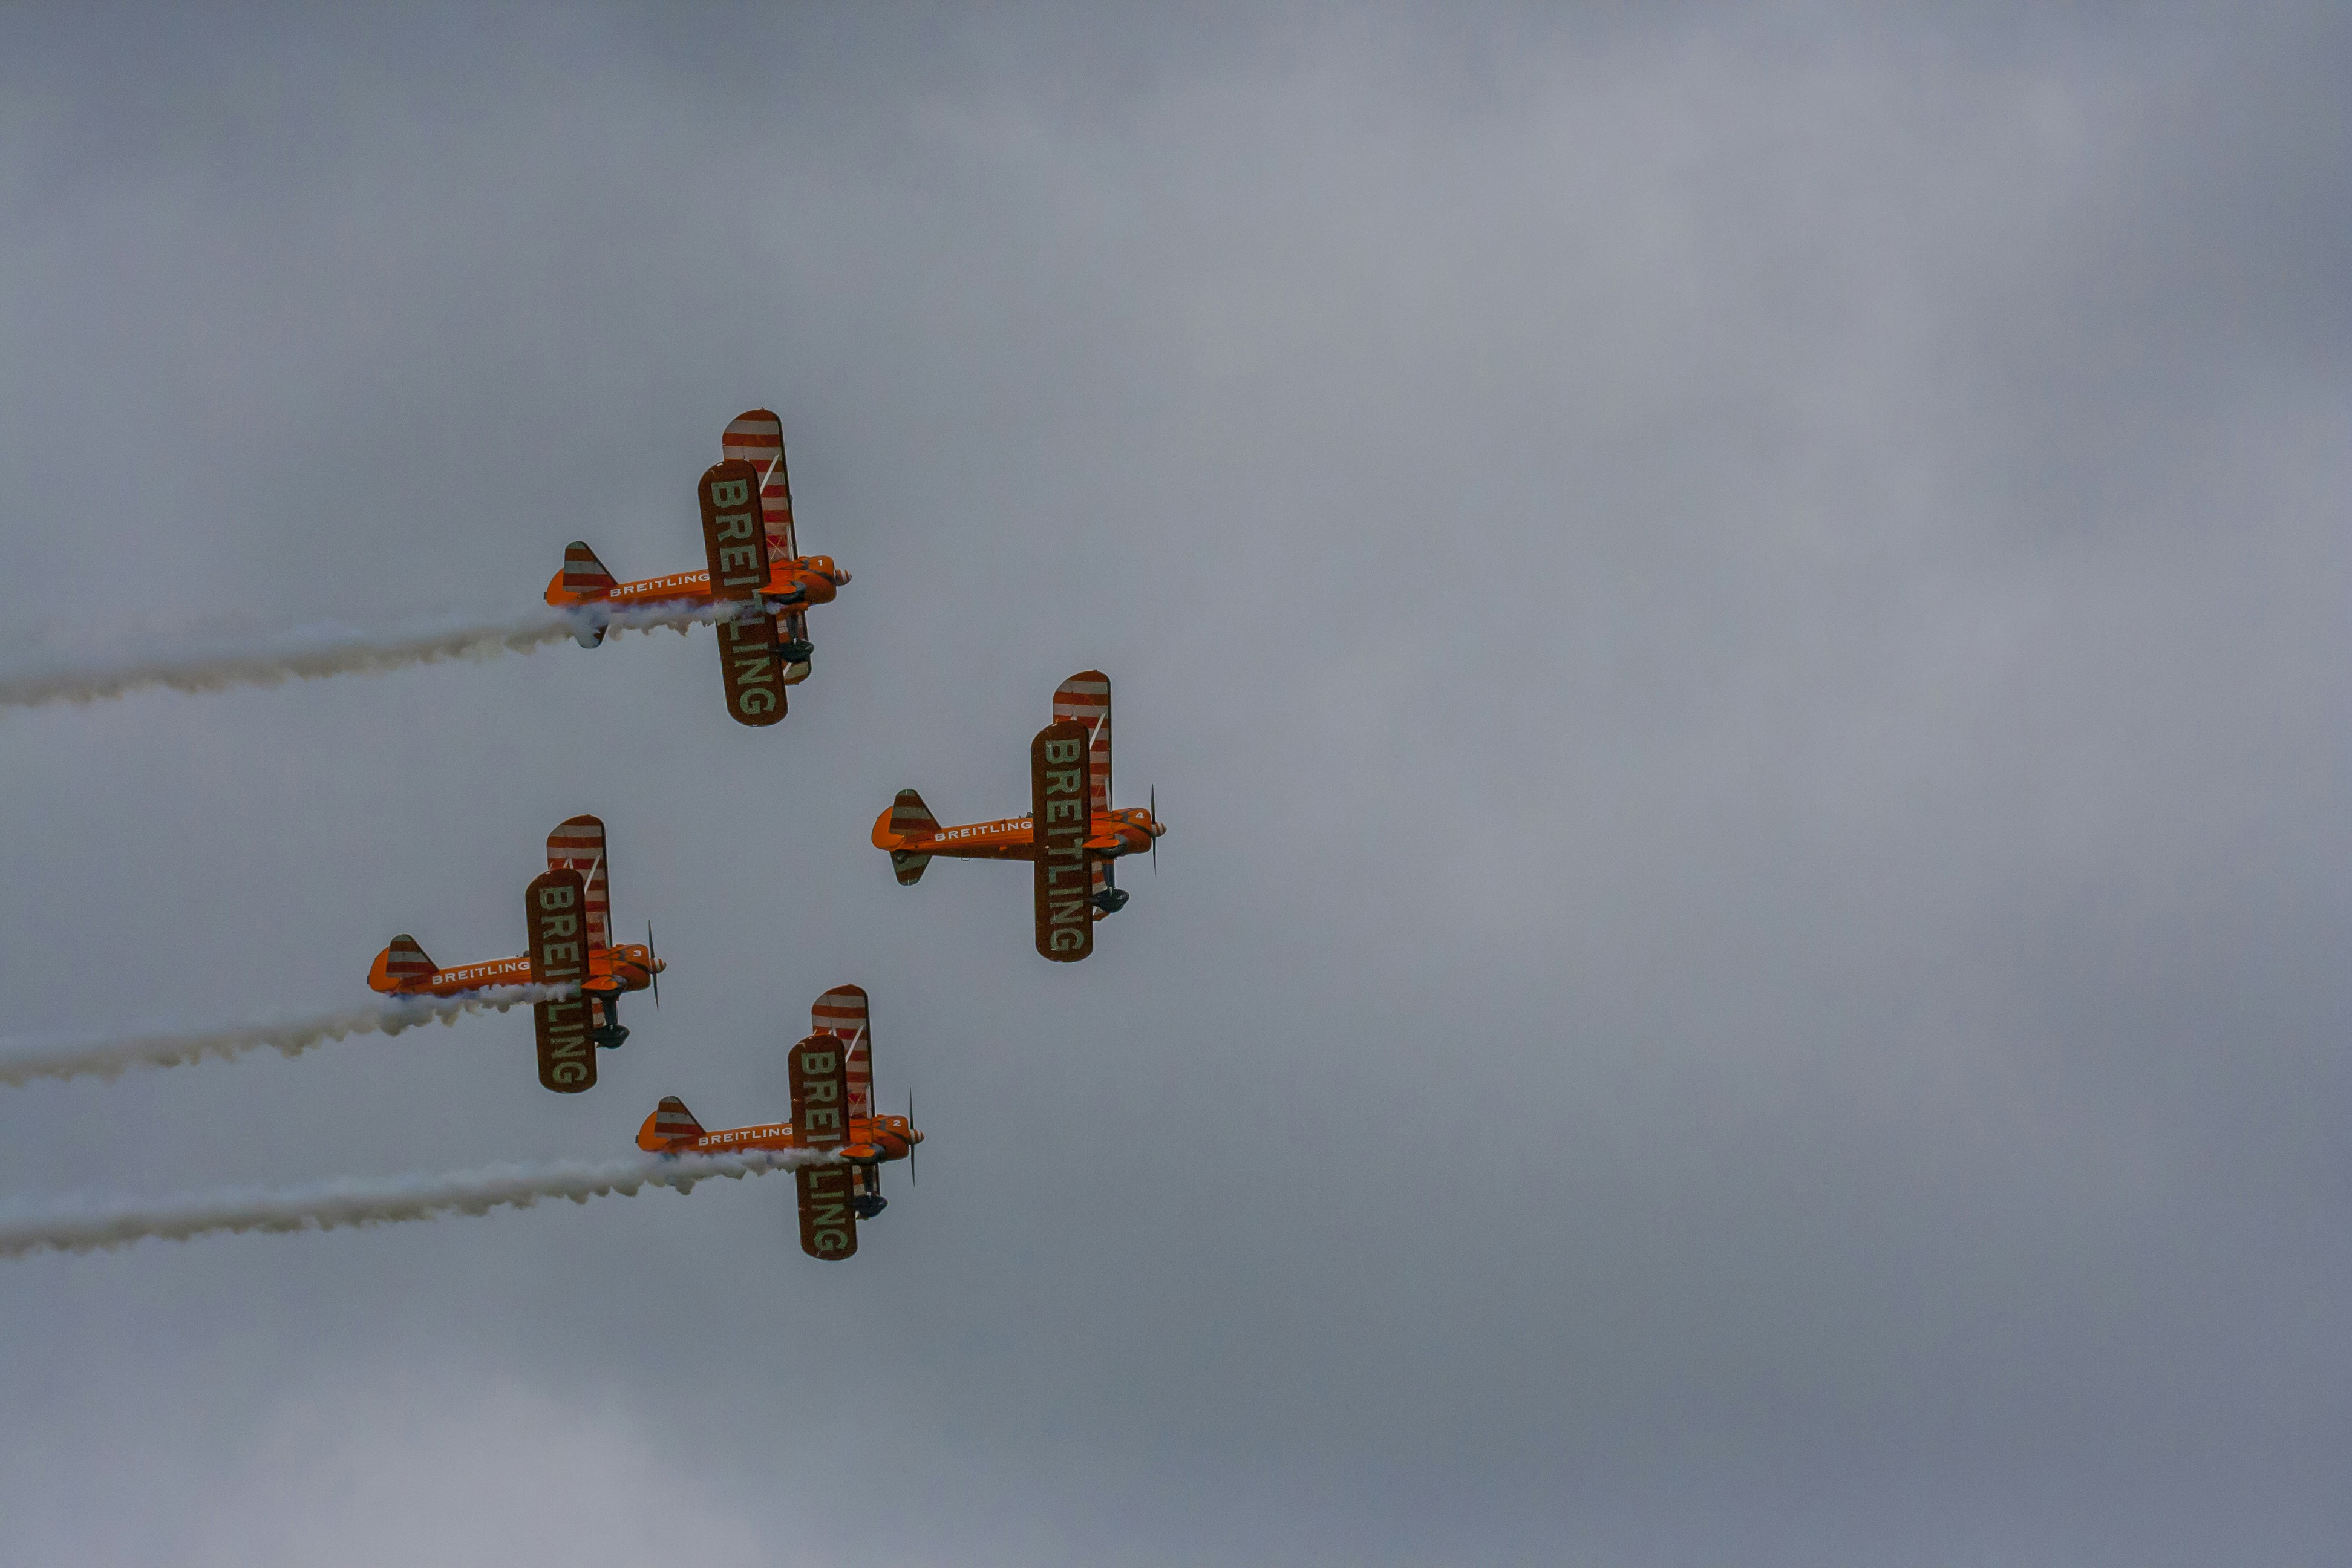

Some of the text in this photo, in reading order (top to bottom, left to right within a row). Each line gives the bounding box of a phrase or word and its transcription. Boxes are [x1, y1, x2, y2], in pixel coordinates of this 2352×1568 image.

[610, 573, 710, 598] BREITLING
[710, 479, 776, 715] BREITLING
[935, 822, 1033, 841] BREITLING
[1045, 739, 1085, 952] BREITLING
[432, 961, 531, 985] BREITLING
[698, 1127, 793, 1146] BREITLING
[800, 1051, 848, 1252] BREILING
